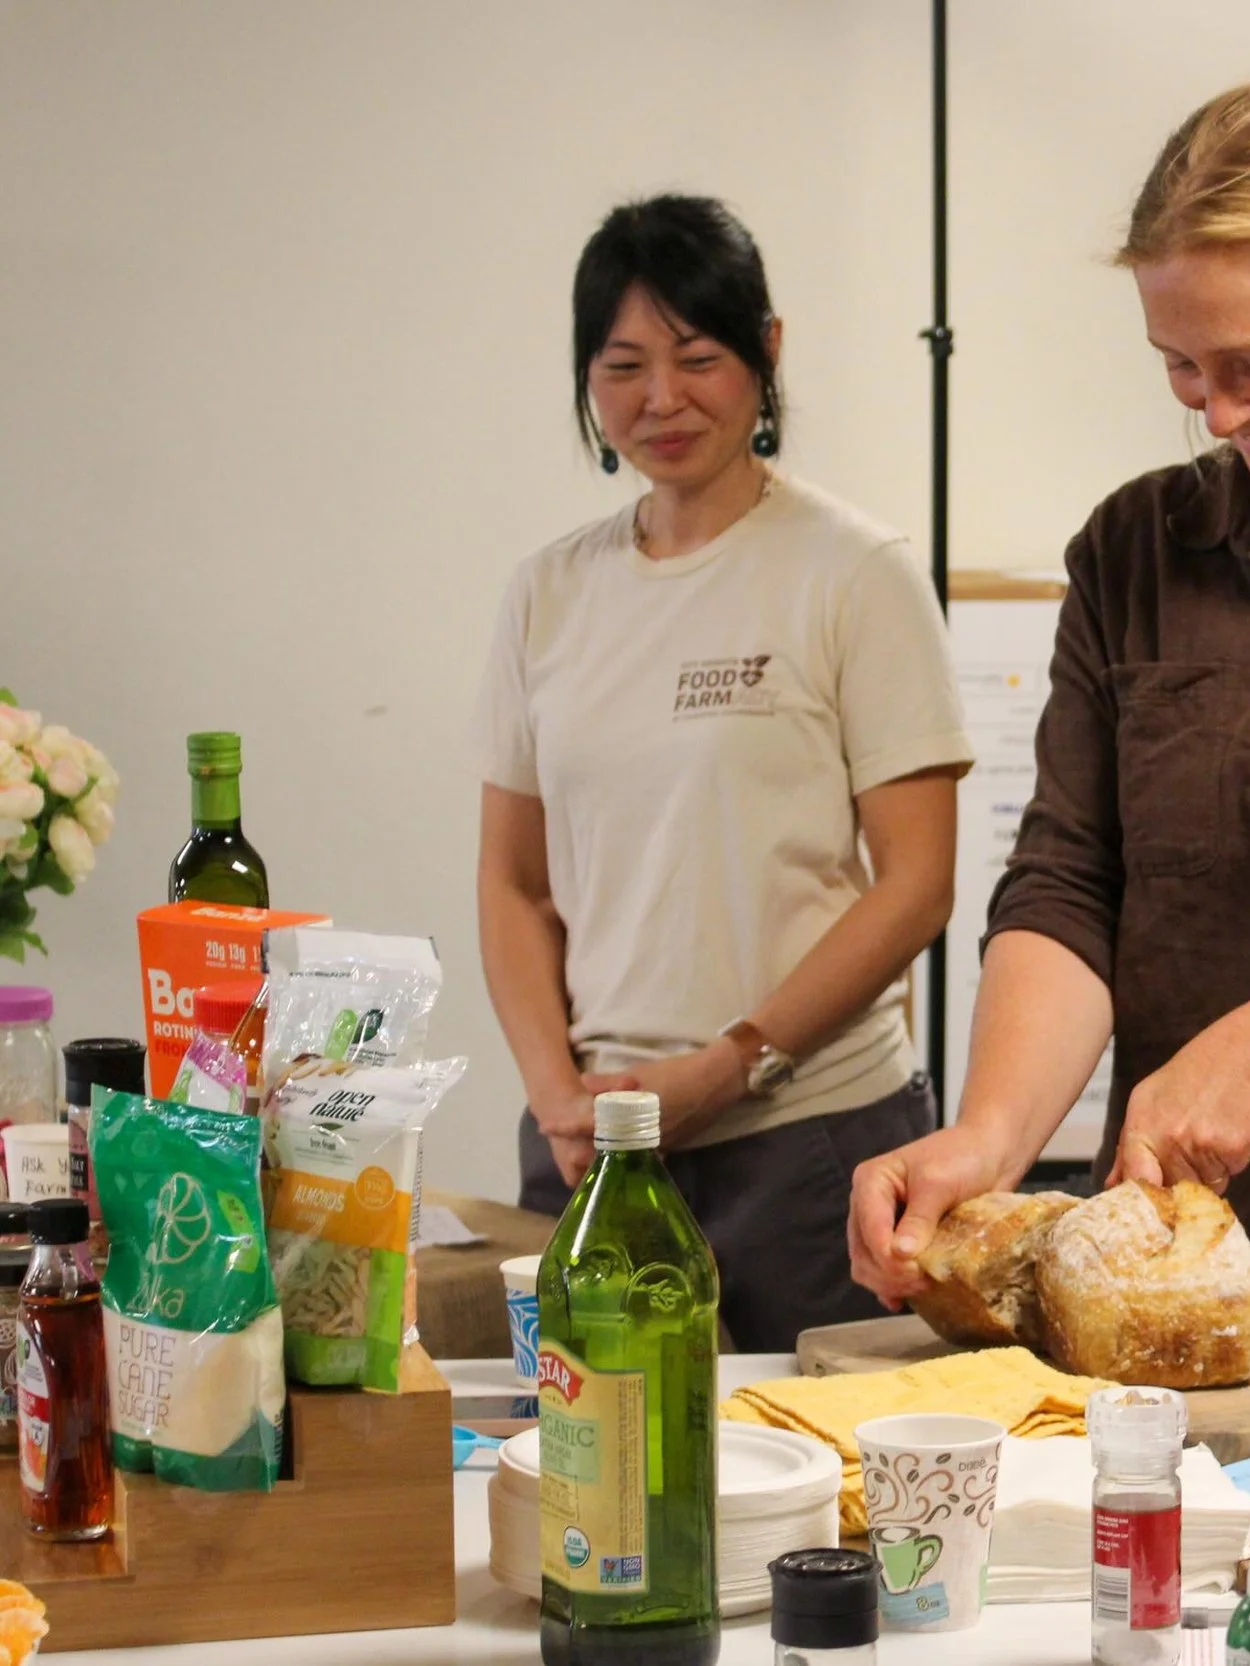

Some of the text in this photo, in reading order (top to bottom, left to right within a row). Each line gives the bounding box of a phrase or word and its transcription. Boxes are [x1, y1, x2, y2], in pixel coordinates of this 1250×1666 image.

[677, 669, 737, 690] FOOD
[673, 690, 732, 712] FARM
[206, 941, 225, 960] 20g
[229, 943, 246, 963] 13g
[328, 1089, 376, 1106] open
[293, 1184, 345, 1212] ALMONDS
[119, 1324, 176, 1367] PURE
[118, 1360, 173, 1400] CANE
[539, 1356, 571, 1398] STAR
[118, 1390, 169, 1427] SUGAR
[541, 1414, 595, 1448] GANIC
